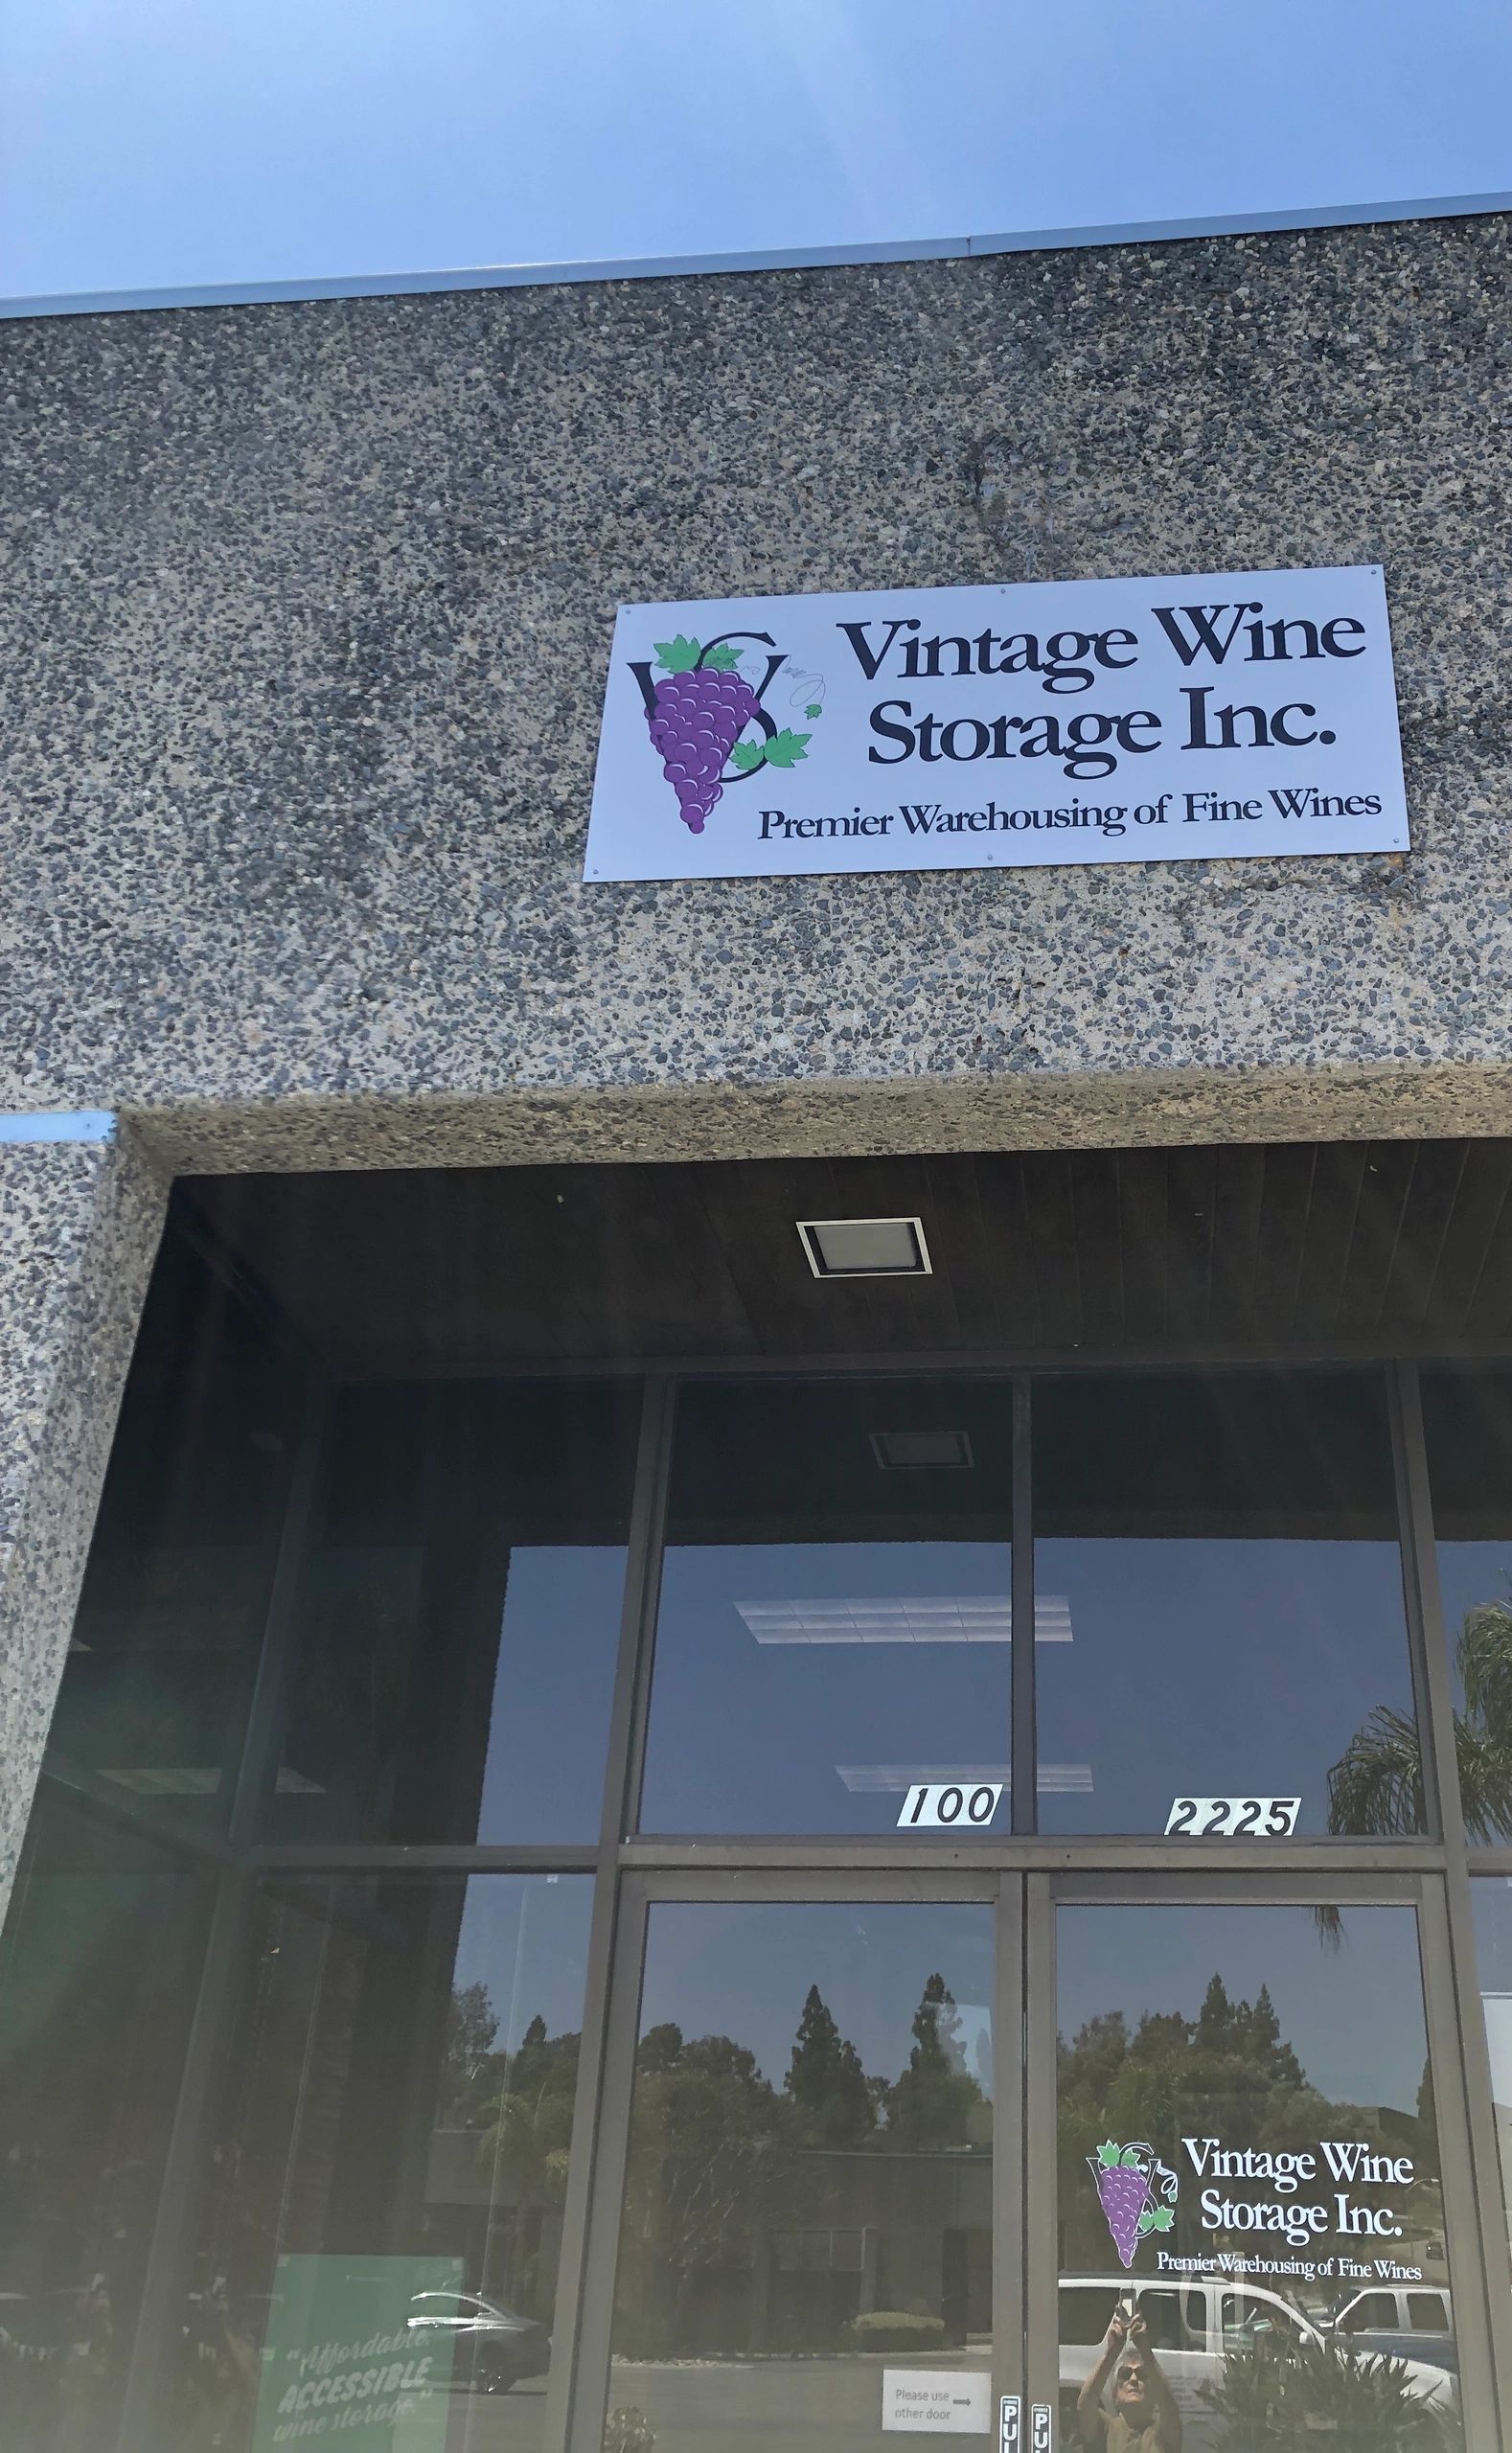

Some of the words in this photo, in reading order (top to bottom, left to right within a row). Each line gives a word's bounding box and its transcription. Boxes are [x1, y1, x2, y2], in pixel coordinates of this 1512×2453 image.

[836, 619, 1139, 695] Vintage
[1151, 602, 1367, 666] Wine
[868, 699, 1162, 780] Storage
[1179, 686, 1337, 749] Inc.
[757, 807, 894, 840] Premier
[899, 796, 1128, 837] Warehousing
[1134, 793, 1172, 824] of
[1182, 791, 1263, 823] Fine
[1268, 787, 1382, 819] Wines
[910, 1787, 995, 1823] 100
[1169, 1800, 1294, 1837] 2225
[1181, 2138, 1317, 2193] Vintage
[1319, 2142, 1414, 2184] Wine
[1201, 2189, 1329, 2246] Storage
[1334, 2193, 1403, 2236] Inc.
[1157, 2252, 1216, 2272] Premier
[1217, 2254, 1315, 2281] Warehousing
[1317, 2258, 1334, 2276] of
[1338, 2258, 1372, 2278] Fine
[1374, 2259, 1422, 2281] Wines
[277, 2356, 433, 2414] ACCESSIBLE
[896, 2389, 928, 2401] Please
[931, 2392, 950, 2401] use
[273, 2416, 329, 2442] wine
[895, 2408, 924, 2419] other
[926, 2407, 951, 2419] door
